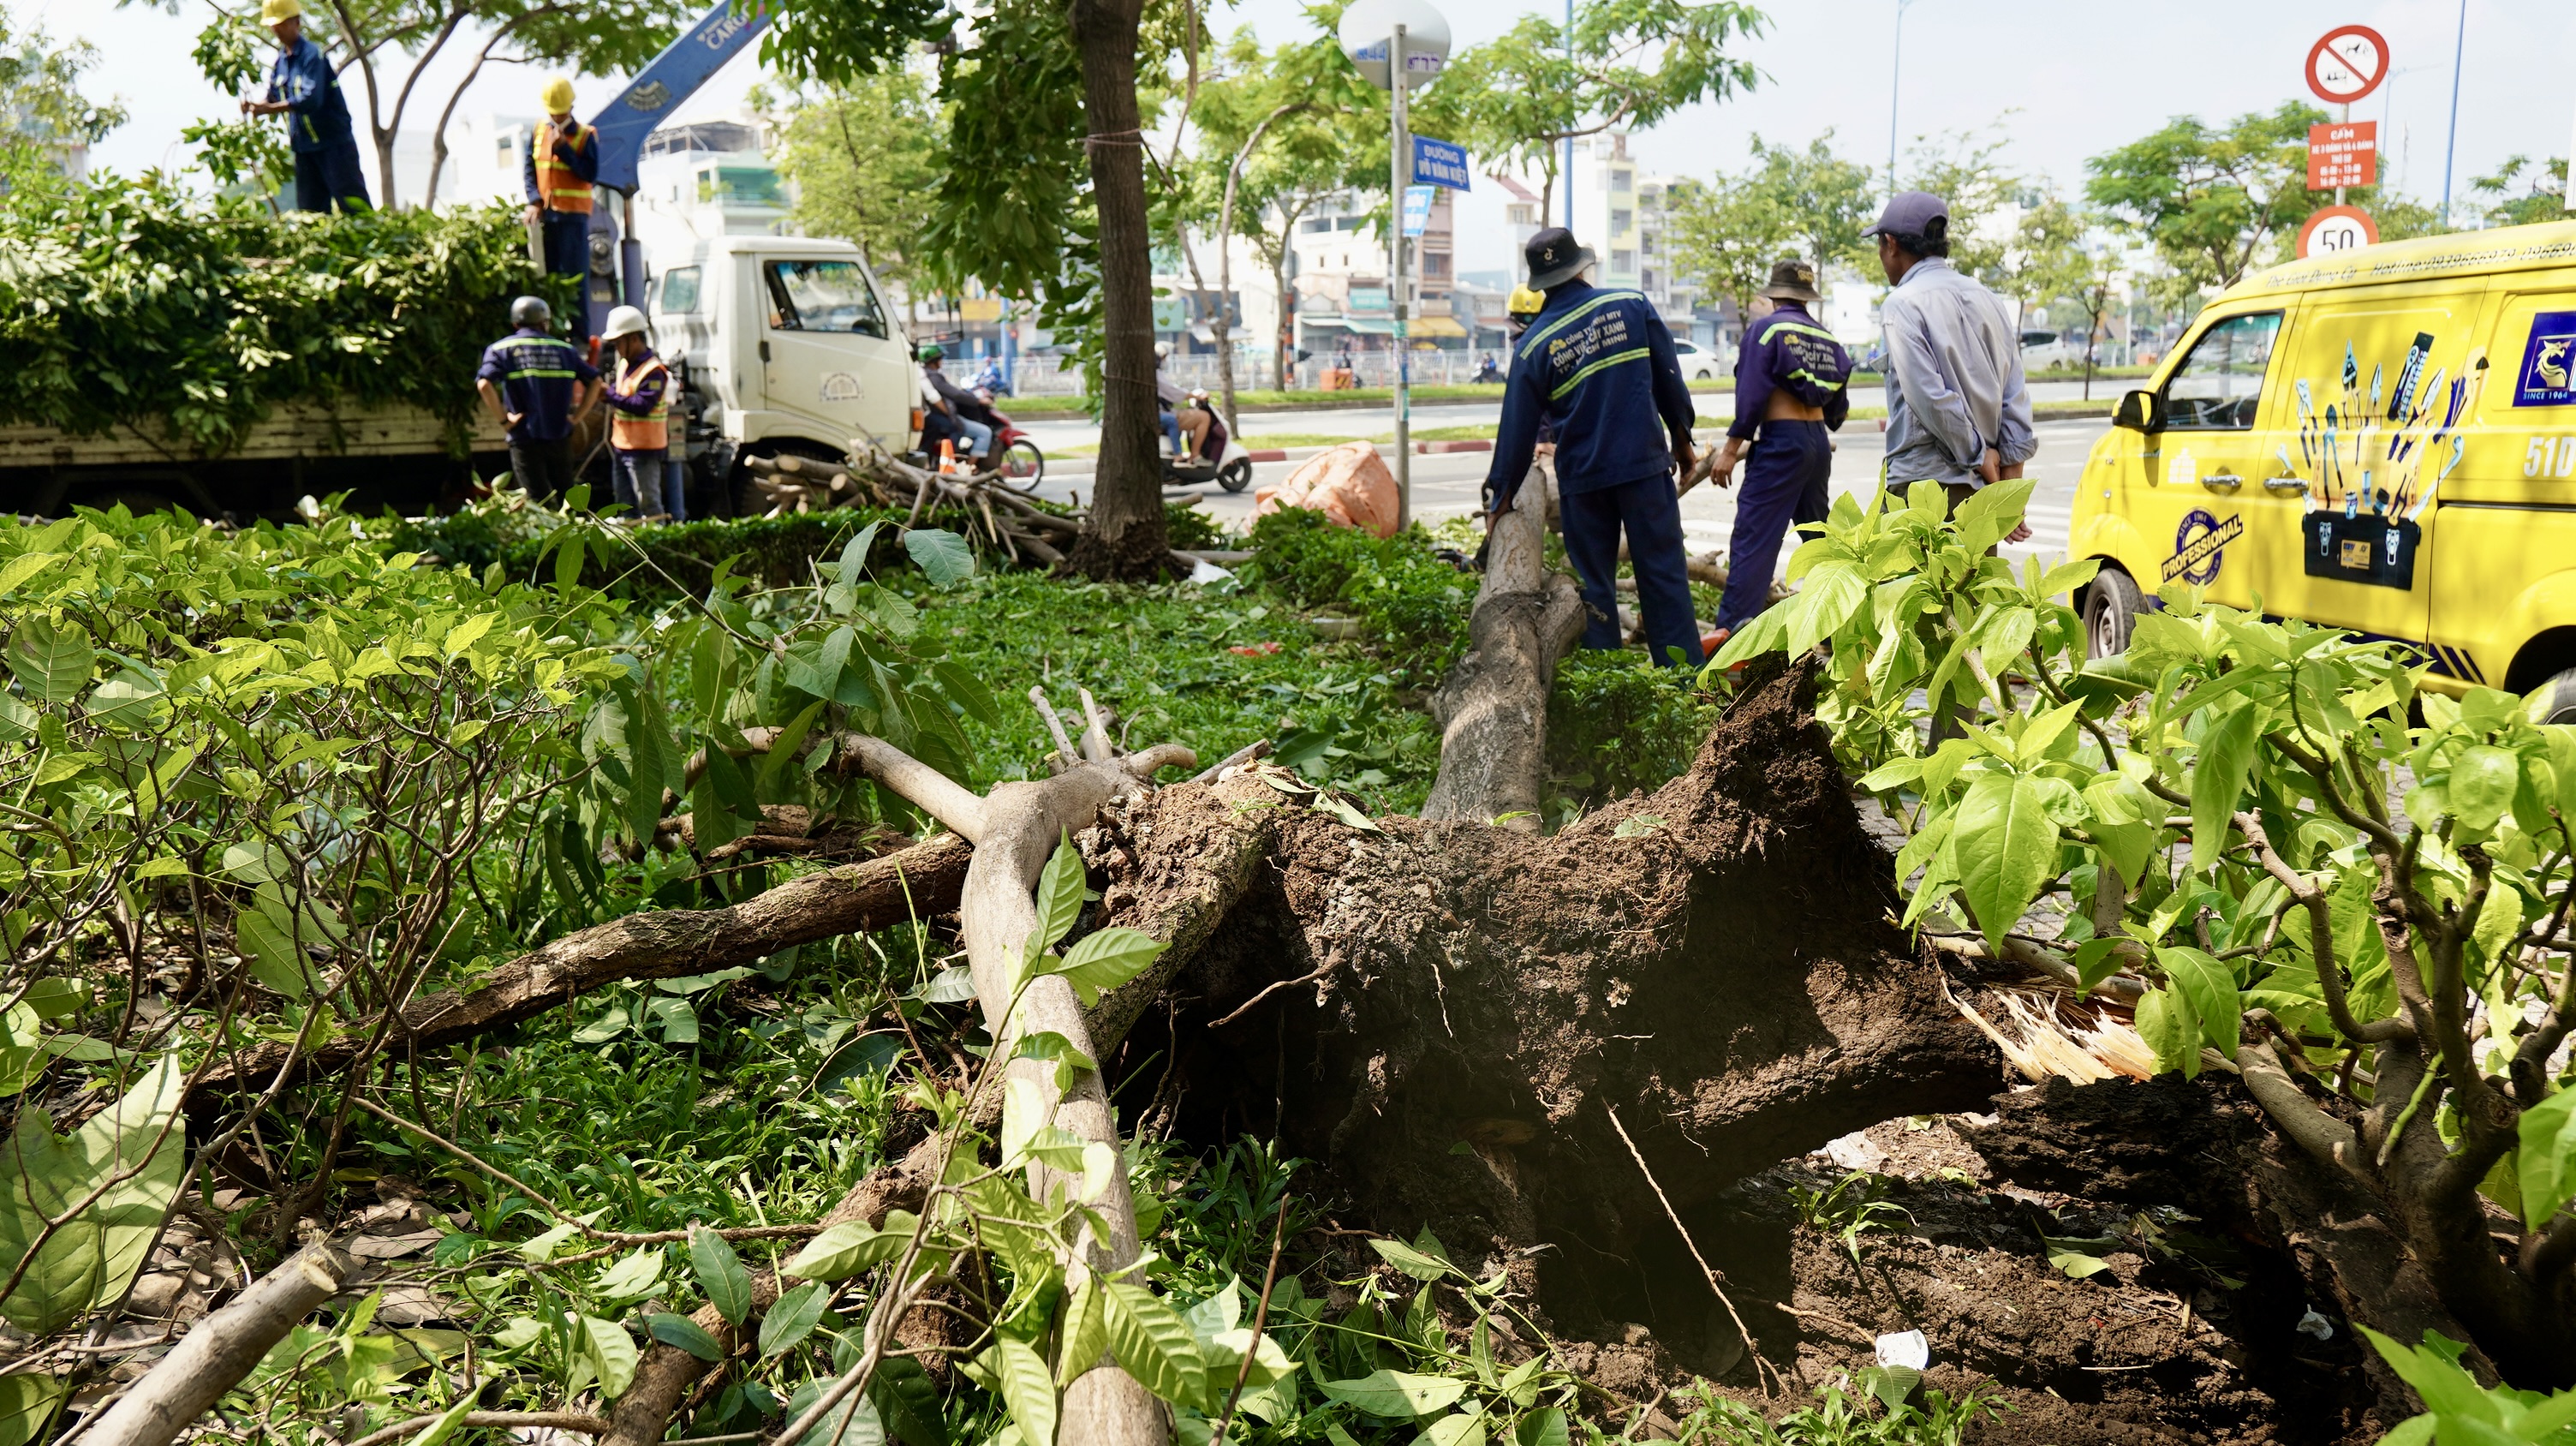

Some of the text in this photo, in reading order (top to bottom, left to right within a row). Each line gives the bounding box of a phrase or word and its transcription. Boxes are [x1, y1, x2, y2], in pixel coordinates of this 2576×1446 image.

[1553, 349, 1576, 367] CÔNG
[1602, 320, 1625, 336] XANH
[1601, 332, 1628, 348] MINH
[2522, 391, 2568, 401] SINCE 1964
[2162, 517, 2243, 582] PROFESSIONAL
